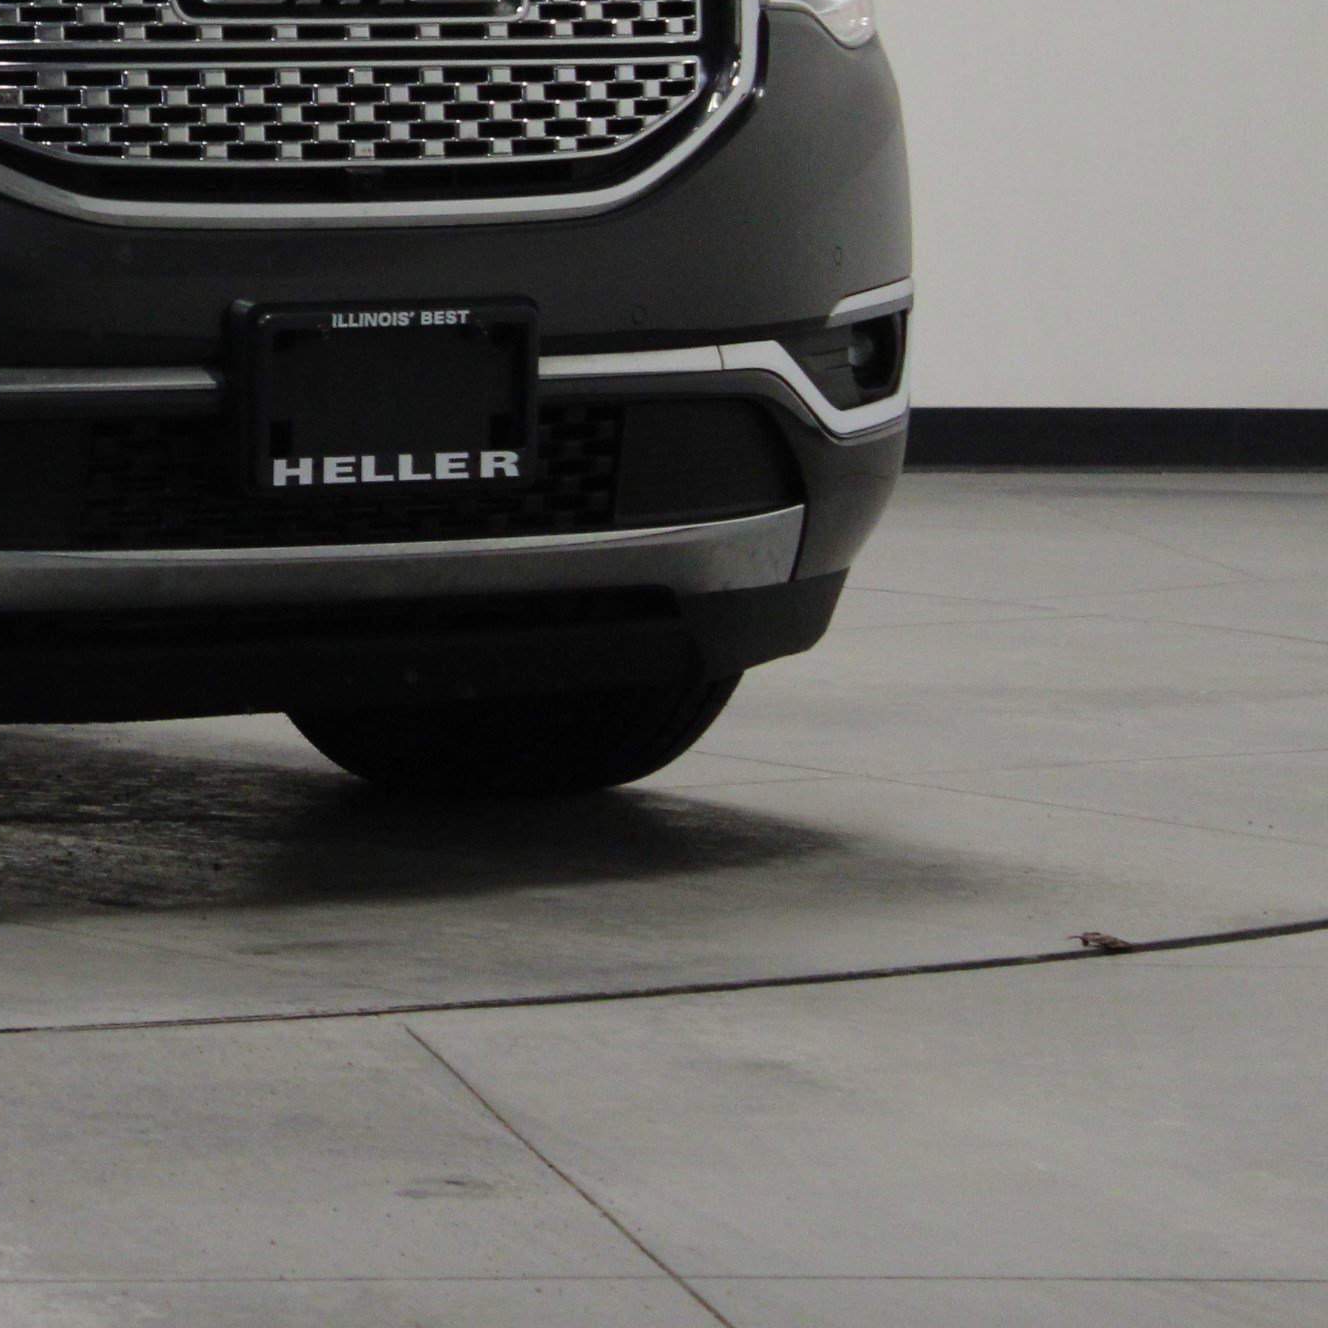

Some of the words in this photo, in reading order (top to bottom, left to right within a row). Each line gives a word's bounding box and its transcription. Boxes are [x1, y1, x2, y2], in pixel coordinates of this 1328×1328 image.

[331, 310, 416, 328] ILLINOIS'
[420, 309, 471, 325] BEST
[272, 449, 520, 487] HELLER
